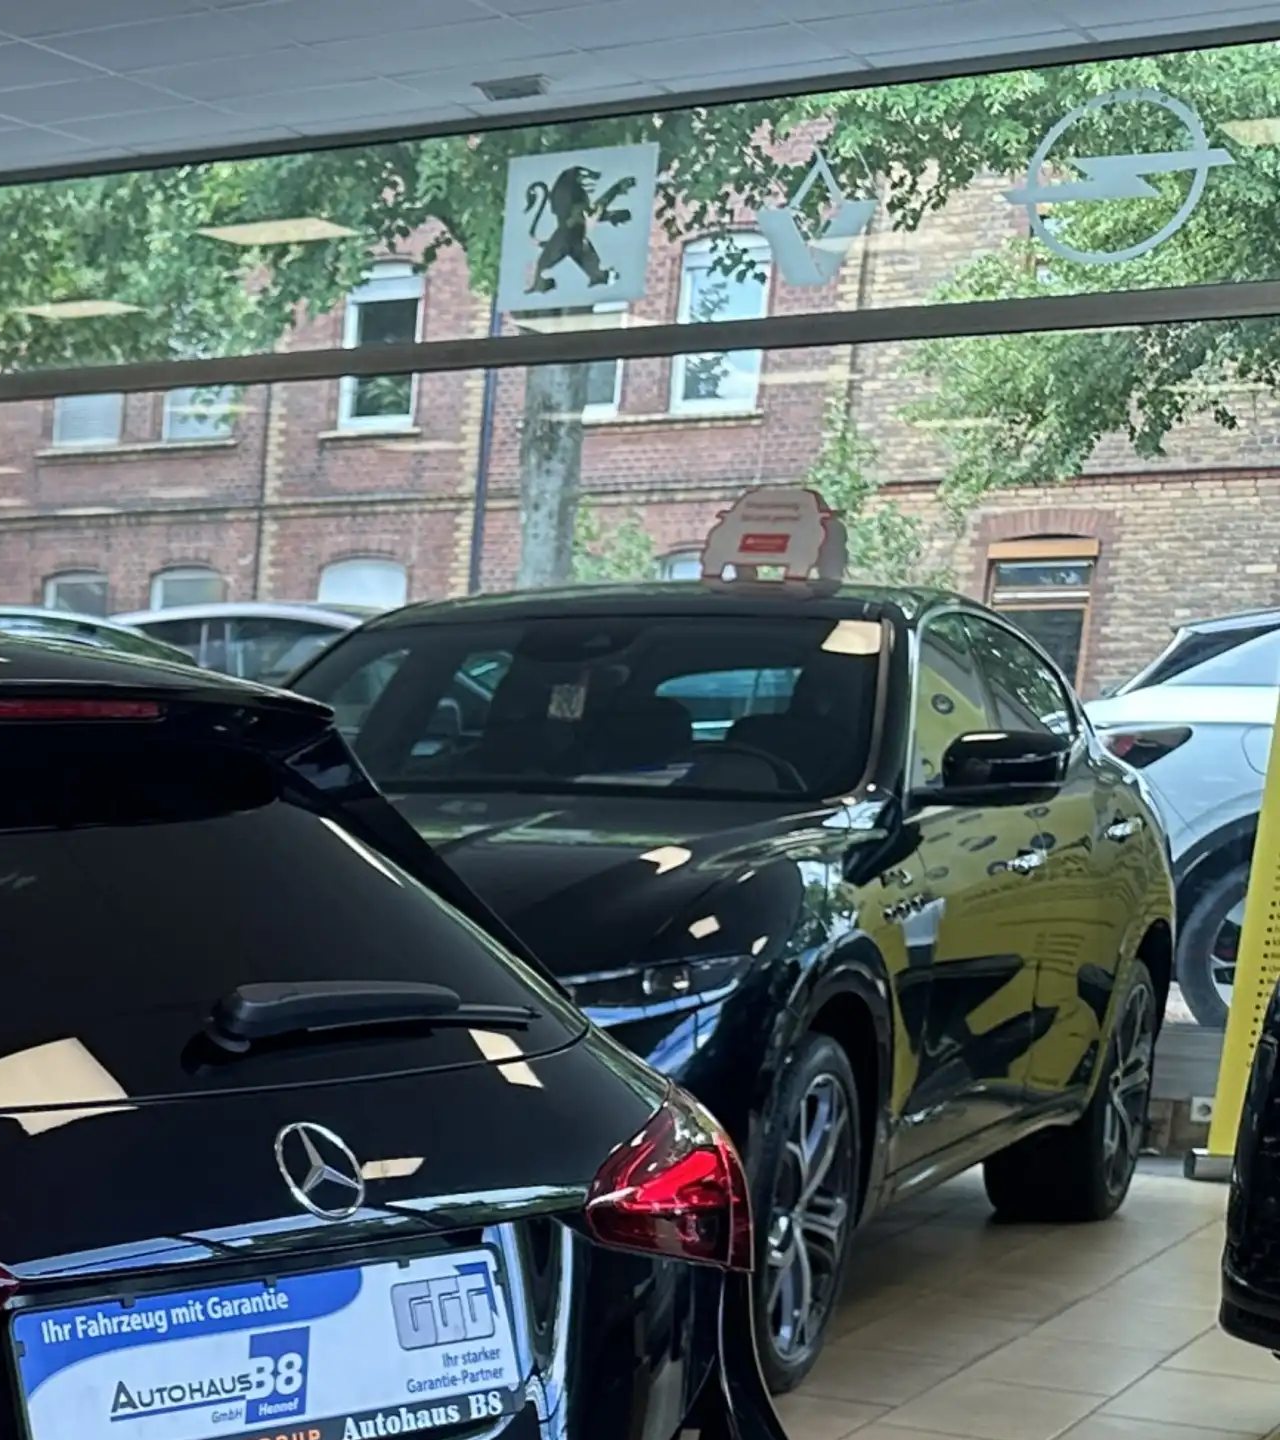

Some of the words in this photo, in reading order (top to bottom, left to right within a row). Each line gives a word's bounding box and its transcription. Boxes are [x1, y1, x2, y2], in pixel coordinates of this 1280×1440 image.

[41, 1318, 72, 1344] Ihr
[75, 1308, 168, 1340] Fahrzeug
[171, 1299, 206, 1325] mit
[207, 1288, 289, 1319] Garantie
[442, 1352, 459, 1368] Ihr
[461, 1346, 501, 1365] starker
[406, 1366, 504, 1394] Garantie-Partner
[211, 1407, 243, 1424] GmbH
[257, 1397, 300, 1416] Hennef
[467, 1391, 504, 1419] B8
